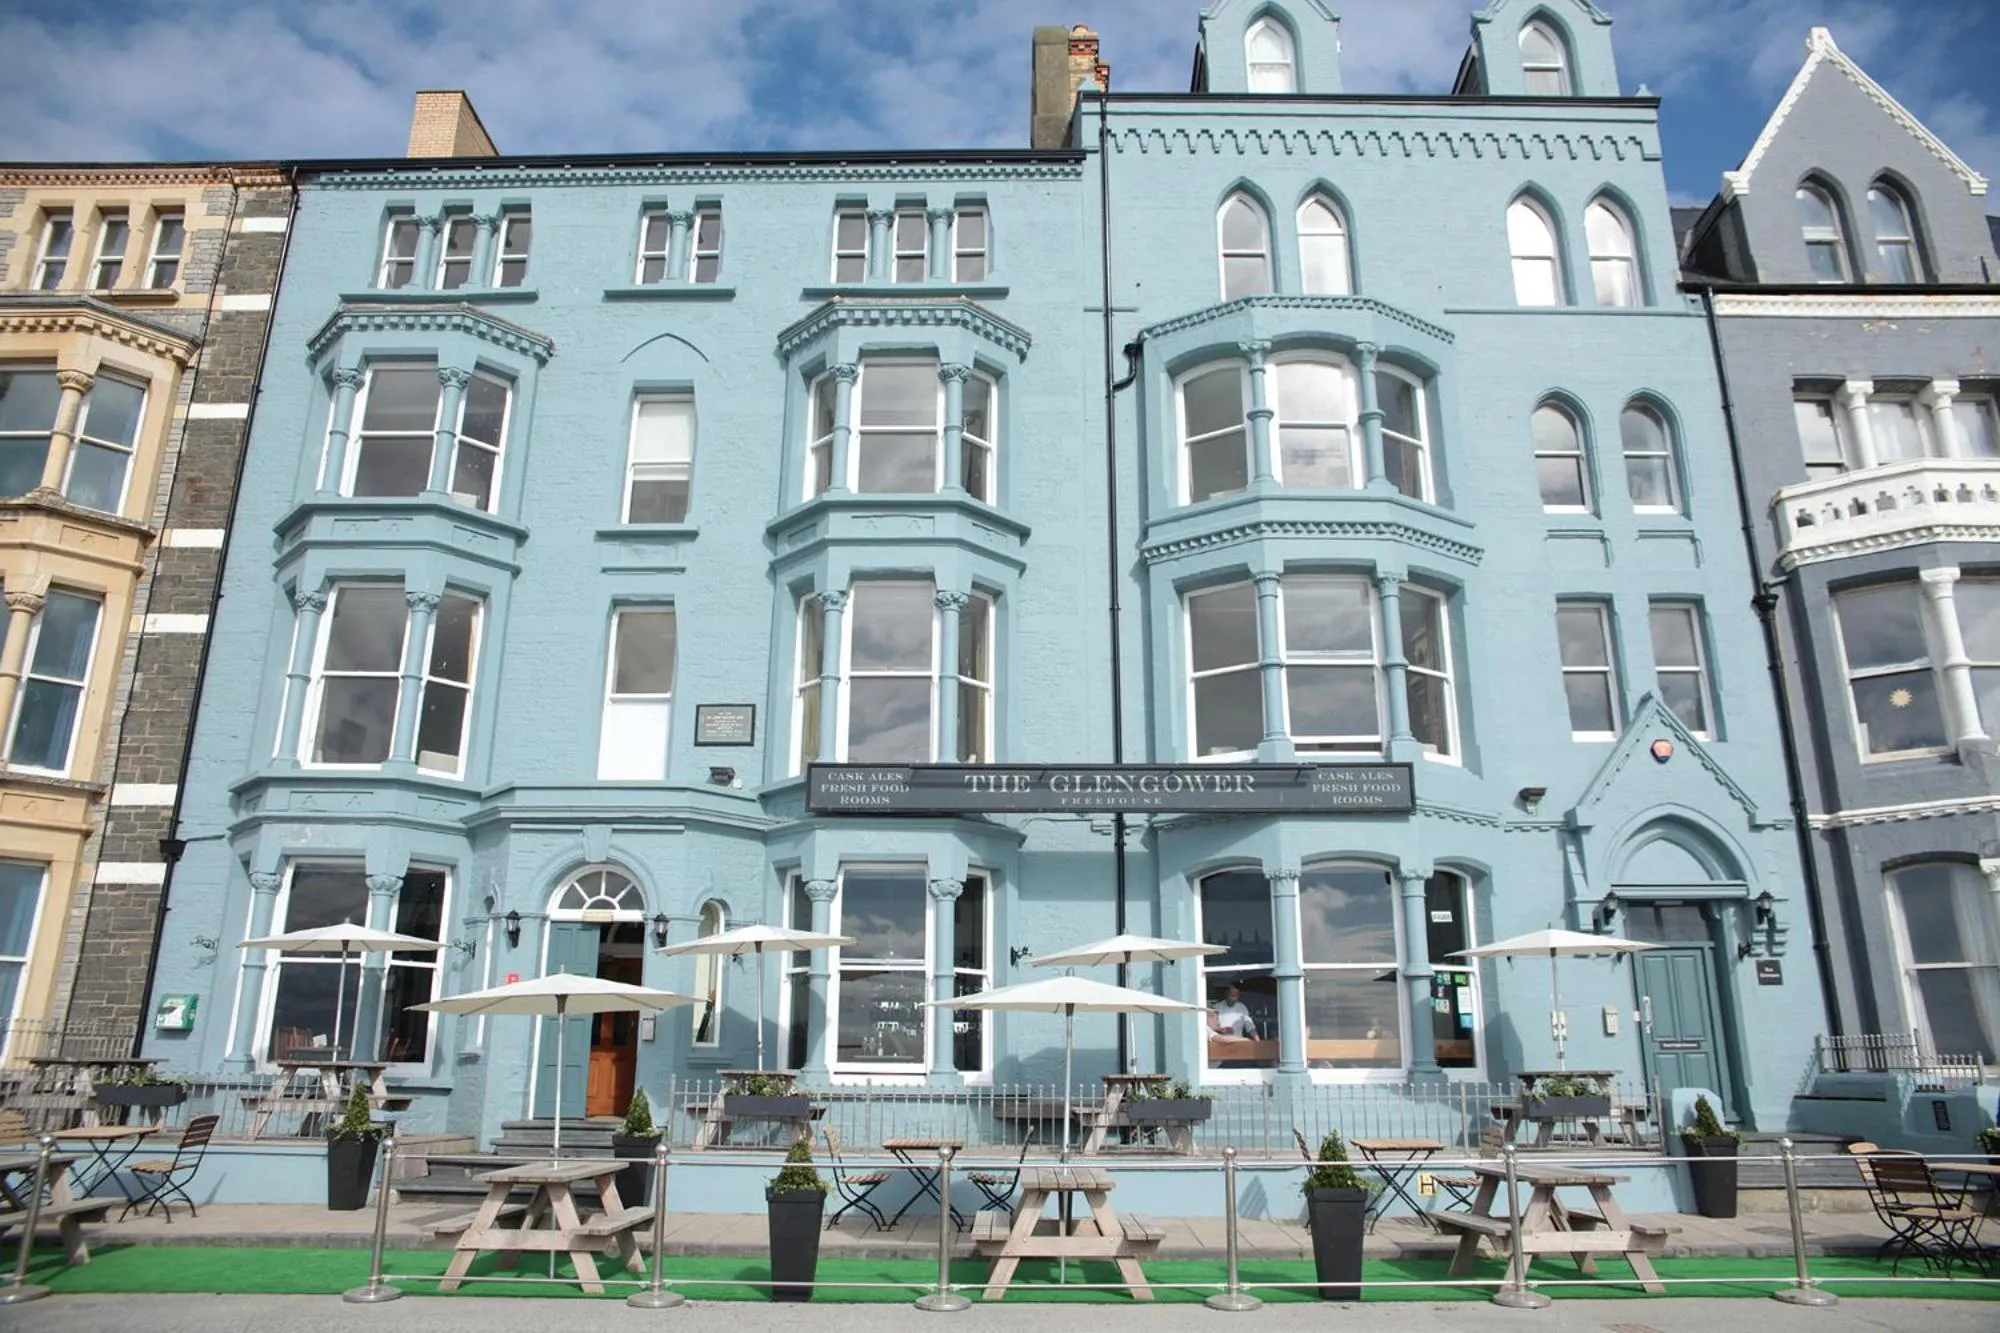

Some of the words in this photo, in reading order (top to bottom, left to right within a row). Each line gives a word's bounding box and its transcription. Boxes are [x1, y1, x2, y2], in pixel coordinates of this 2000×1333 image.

[827, 772, 865, 782] CASK
[869, 772, 905, 782] ALES
[1318, 772, 1355, 782] CASK
[1360, 772, 1395, 782] ALES
[964, 774, 1031, 793] THE
[1050, 774, 1256, 793] GLENGOWER
[821, 784, 868, 794] FRESH
[871, 784, 911, 794] FOOD
[1312, 784, 1359, 794] FRESH
[1363, 784, 1402, 794] FOOD
[840, 796, 891, 806] ROOMS
[1061, 797, 1164, 806] FREEHOUSE
[1332, 796, 1384, 806] ROOMS
[1420, 1175, 1436, 1194] H
